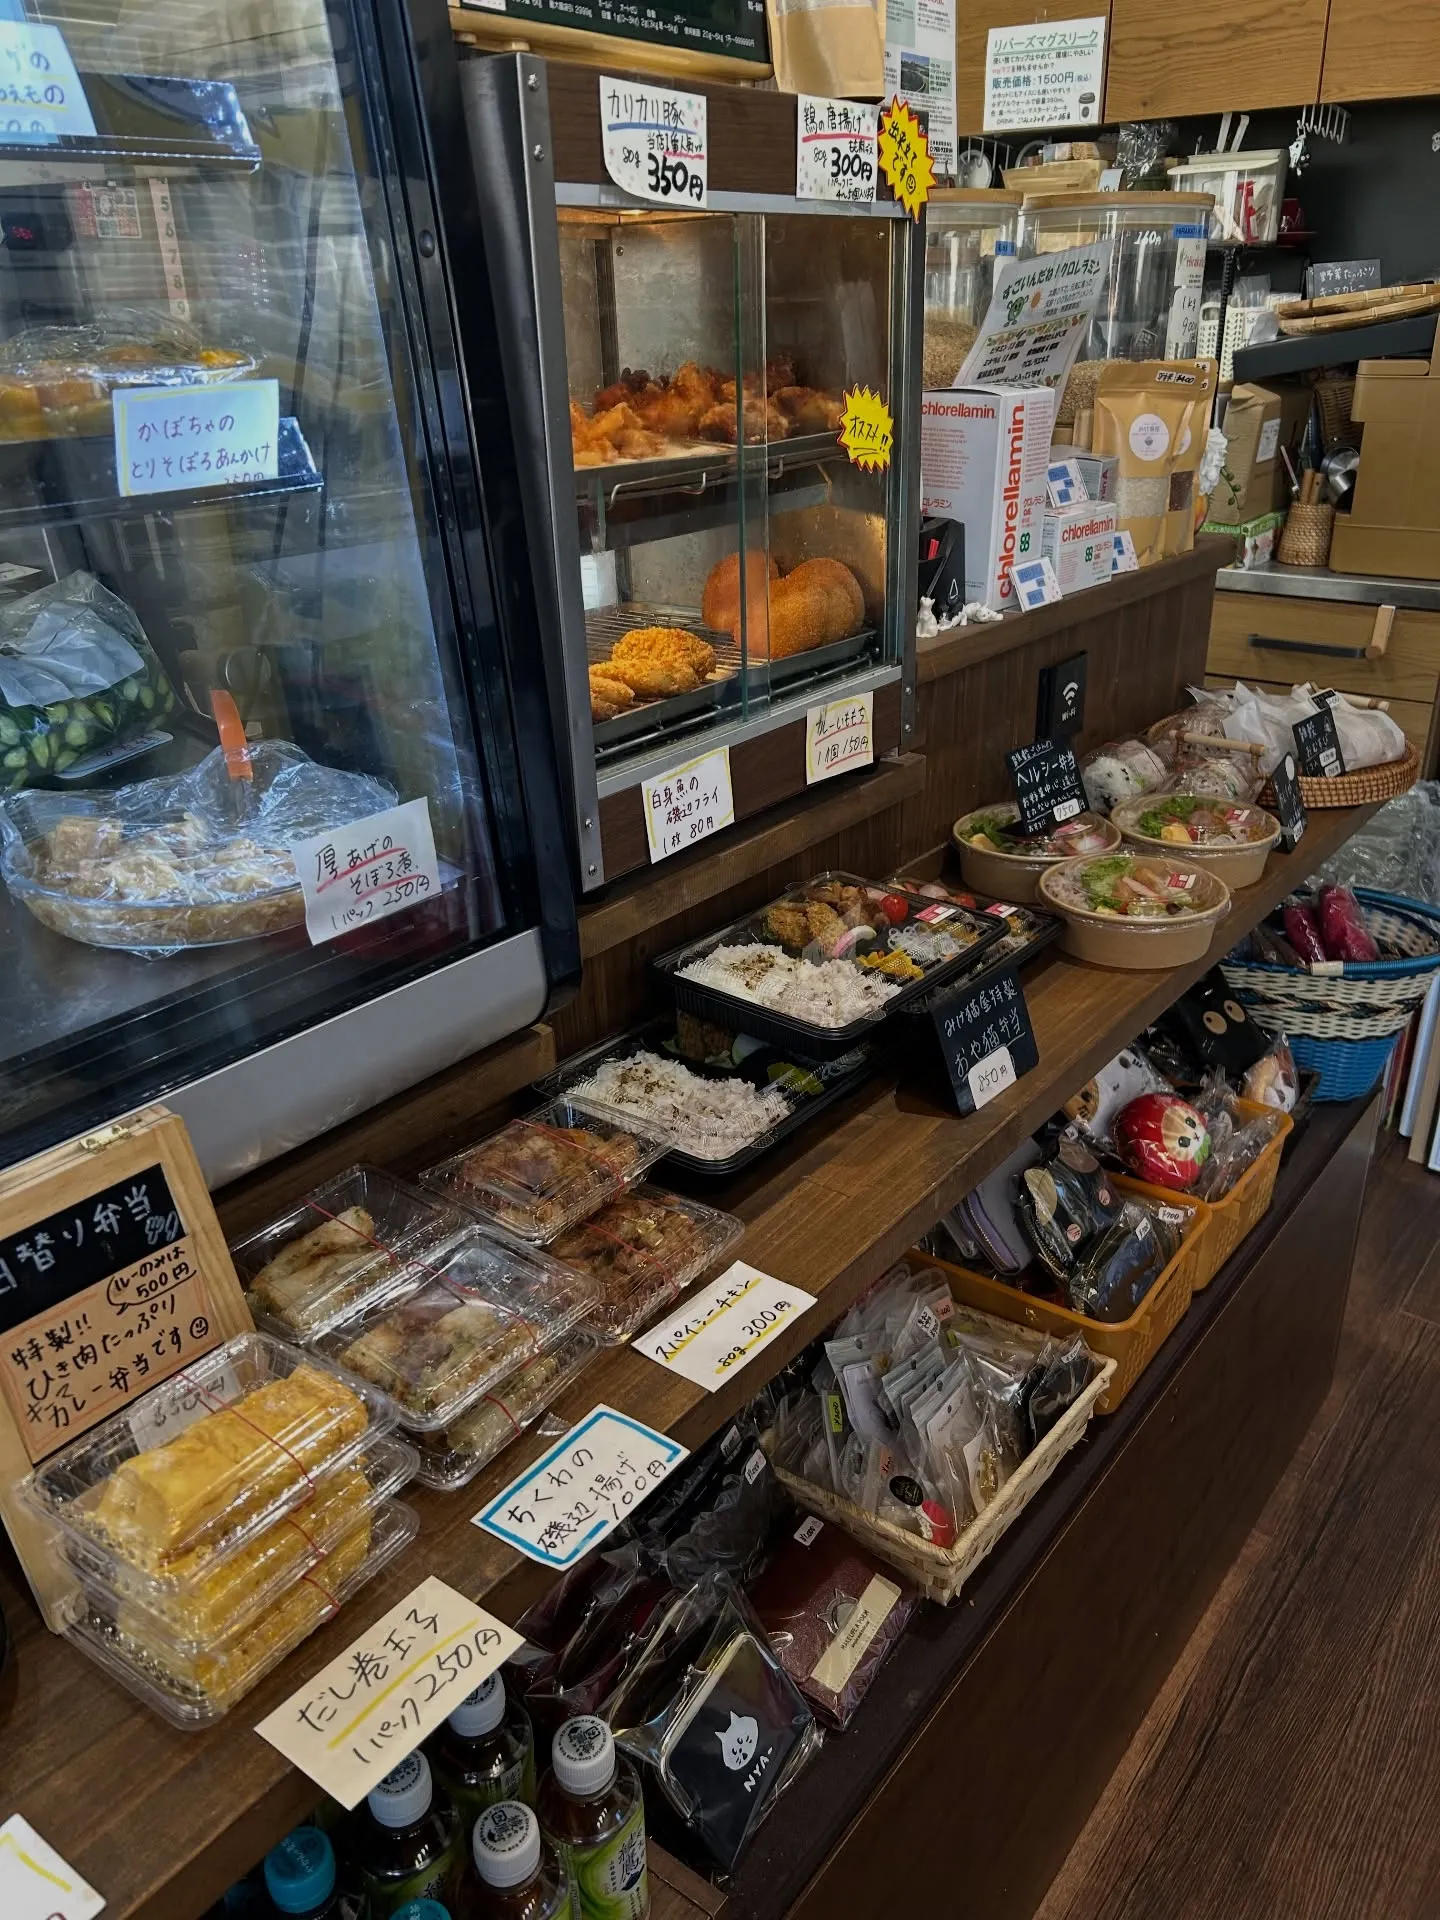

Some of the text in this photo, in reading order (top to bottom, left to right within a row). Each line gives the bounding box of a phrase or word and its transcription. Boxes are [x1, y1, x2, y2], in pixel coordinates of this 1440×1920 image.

[994, 30, 1098, 52] リバーズマグスリーク
[608, 89, 684, 129] カリカリ豚
[804, 102, 862, 134] 鶏の唐揚げ
[648, 152, 704, 202] 350円
[831, 146, 873, 182] 300円
[137, 414, 235, 442] かぼちゃの
[131, 441, 271, 479] とりそぼろあんかけ
[997, 403, 1025, 600] chlorellamin
[1062, 515, 1114, 543] chlorellamin
[1061, 710, 1076, 722] Wi-Fi
[1016, 750, 1077, 788] ヘルシー弁当
[651, 776, 700, 811] 白身魚の
[665, 786, 720, 826] 磯辺フライ
[690, 815, 716, 840] 80円
[314, 834, 394, 883] 厚あげの
[383, 874, 431, 907] 250円
[137, 1260, 192, 1301] 500円
[654, 1279, 752, 1363] スパイシーチキン
[741, 1299, 792, 1339] 300円
[27, 1293, 177, 1402] ひき肉たっぷり
[508, 1447, 594, 1525] ちくわの
[536, 1450, 638, 1554] 磯辺揚げ
[607, 1459, 667, 1522] 100円
[296, 1607, 440, 1733] だし巻玉子
[414, 1628, 502, 1703] 250円
